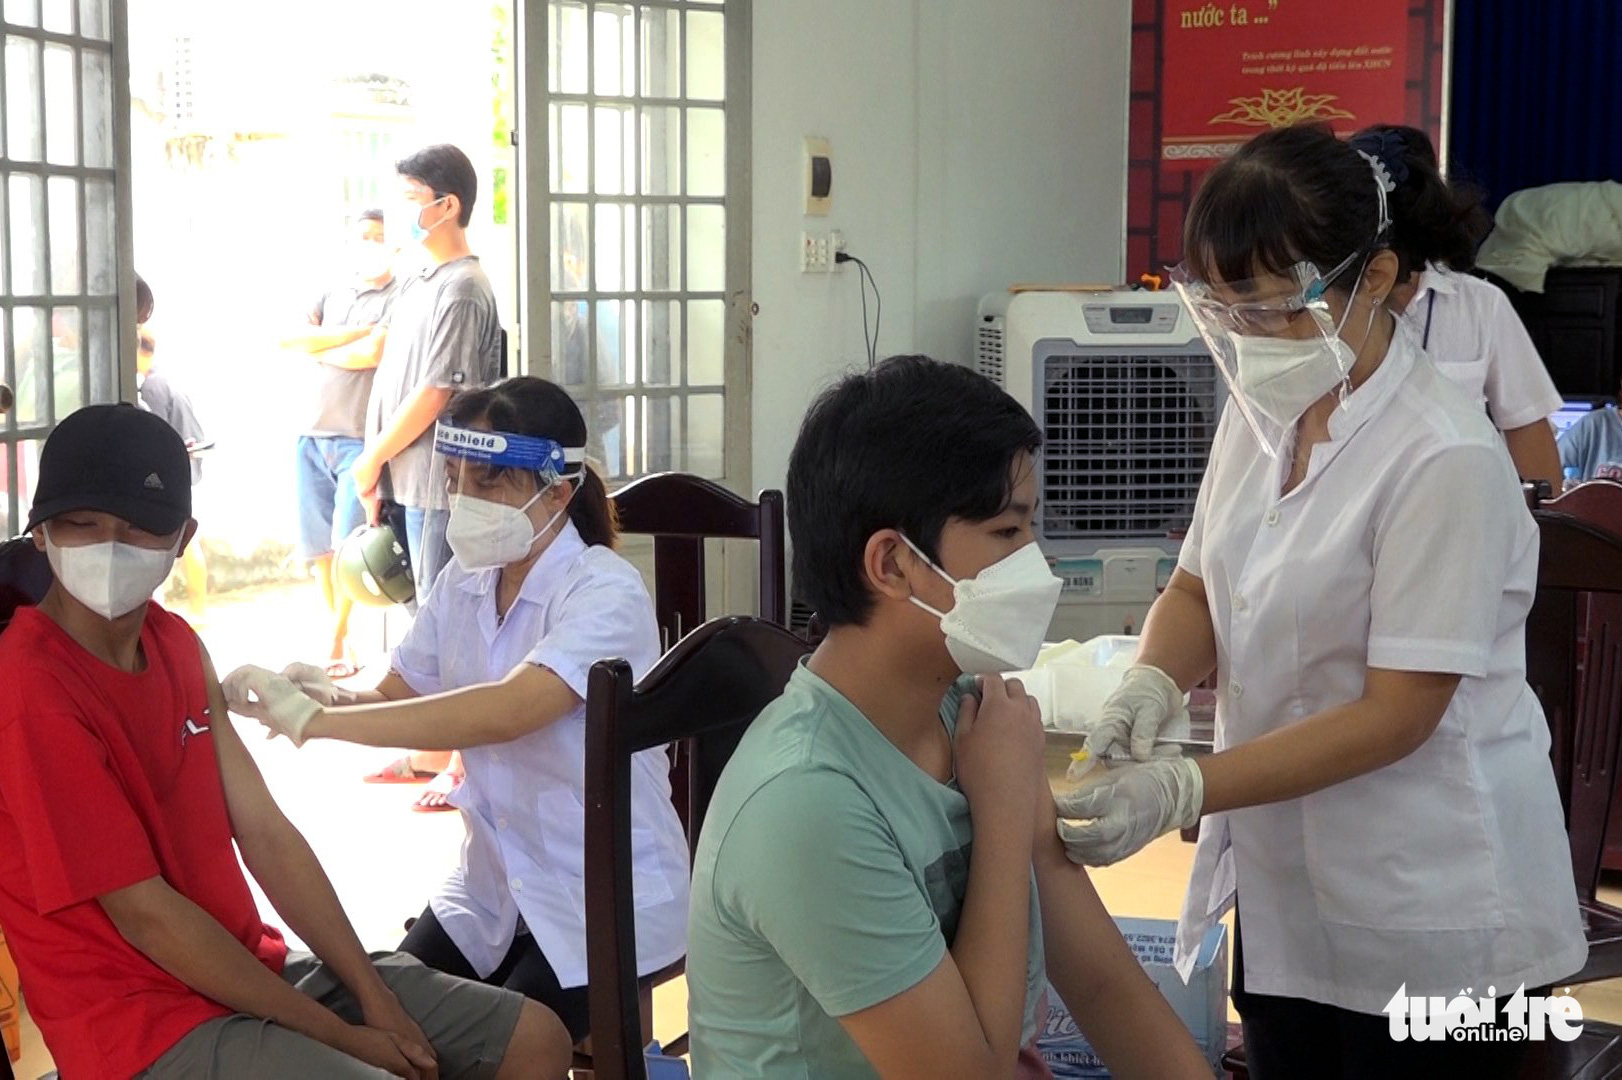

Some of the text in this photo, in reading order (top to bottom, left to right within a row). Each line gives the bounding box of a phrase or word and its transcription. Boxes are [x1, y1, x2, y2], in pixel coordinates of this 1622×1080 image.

[1180, 4, 1224, 29] nước
[1230, 5, 1248, 26] ta
[453, 433, 495, 448] shield
